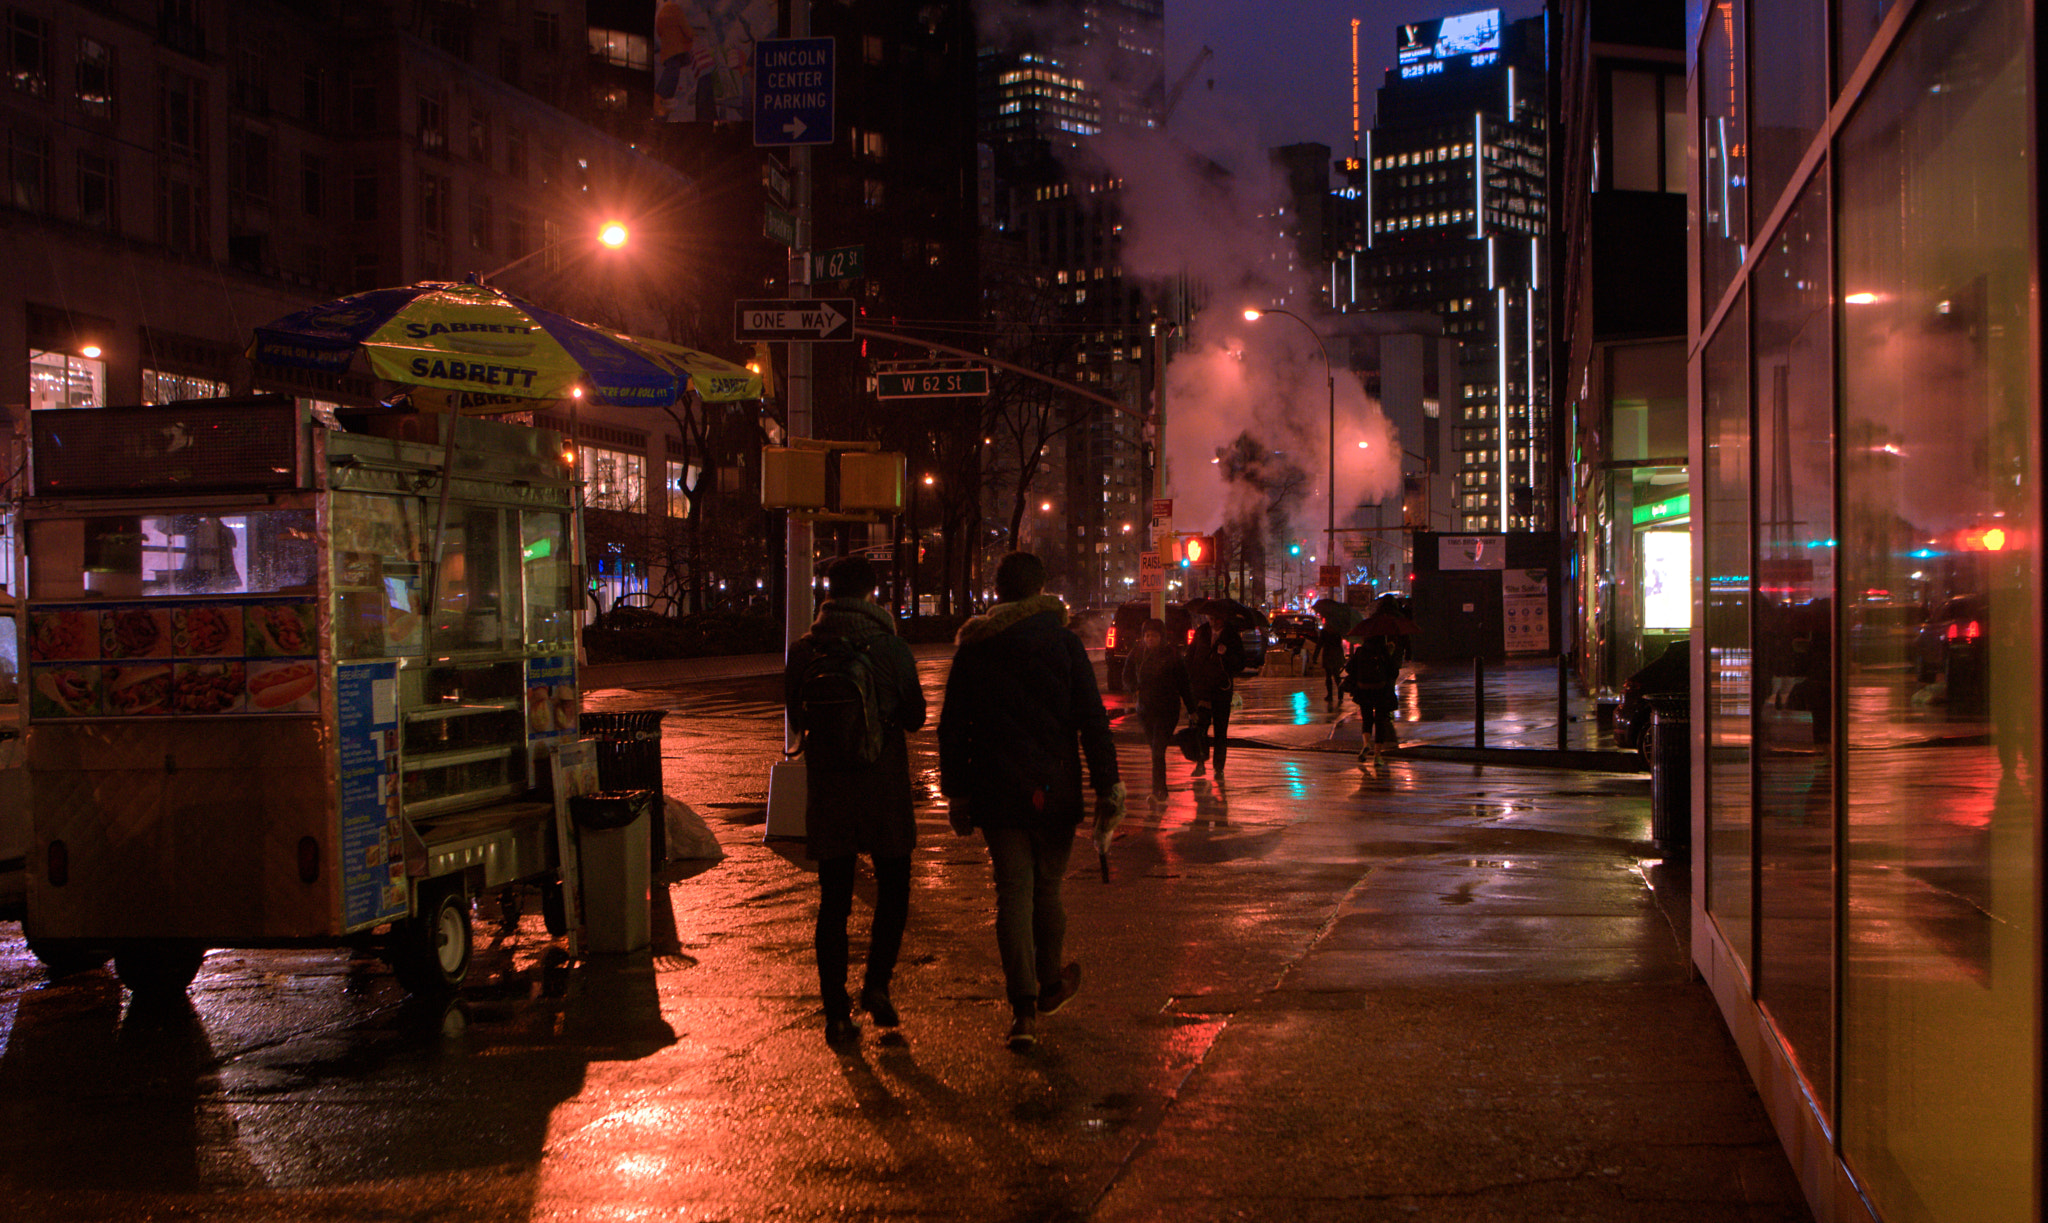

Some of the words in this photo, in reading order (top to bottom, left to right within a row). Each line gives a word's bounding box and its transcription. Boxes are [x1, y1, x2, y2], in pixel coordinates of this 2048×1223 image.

[765, 50, 826, 67] LINCOLN
[1402, 65, 1424, 79] 9:25
[1427, 61, 1443, 75] PM
[768, 71, 822, 88] CENTER
[764, 92, 826, 110] PARKING
[815, 256, 825, 279] W
[829, 252, 844, 277] 62
[850, 251, 857, 266] St
[752, 312, 785, 328] ONE
[801, 312, 835, 328] WAY
[406, 323, 531, 338] SABRETT
[411, 358, 537, 388] SABRETT
[902, 376, 915, 392] W
[922, 376, 940, 391] 62
[947, 375, 962, 391] St
[1142, 574, 1161, 587] PLOW
